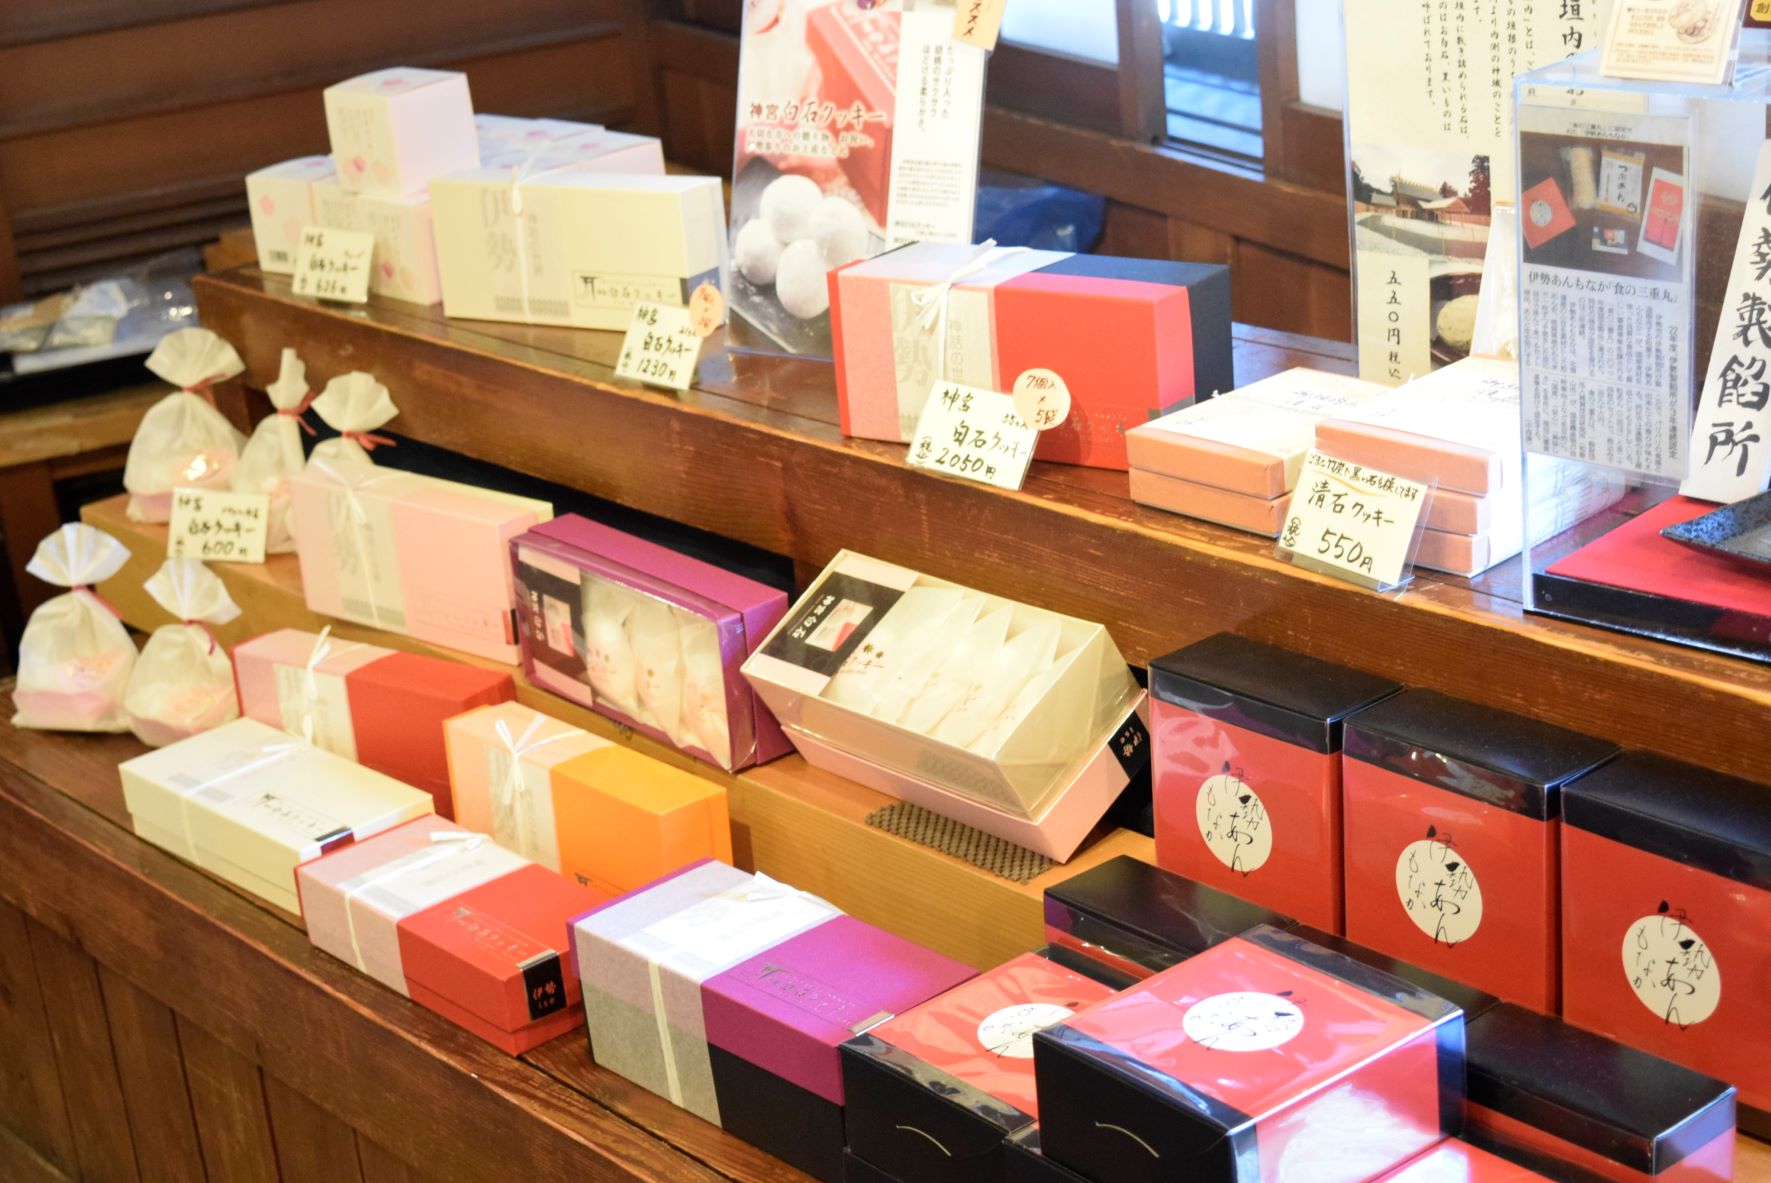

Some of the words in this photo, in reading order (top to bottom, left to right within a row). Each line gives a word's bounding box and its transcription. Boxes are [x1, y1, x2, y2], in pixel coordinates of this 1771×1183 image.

[1489, 0, 1502, 138] より内側の神域のことを
[1703, 177, 1771, 478] 製餡所
[941, 388, 974, 413] 神宮
[935, 447, 997, 480] 2050円
[1317, 527, 1374, 574] 550円
